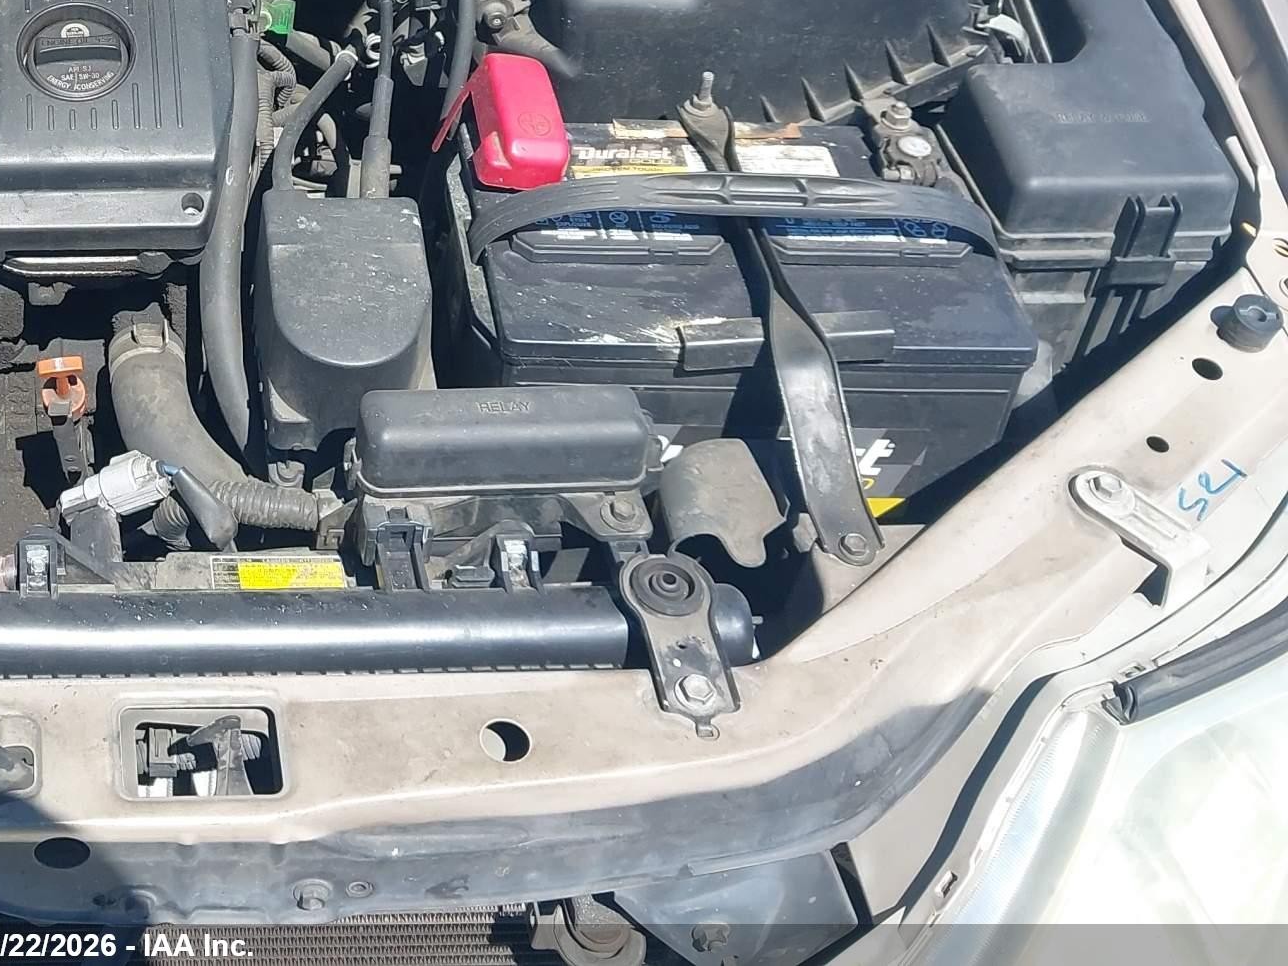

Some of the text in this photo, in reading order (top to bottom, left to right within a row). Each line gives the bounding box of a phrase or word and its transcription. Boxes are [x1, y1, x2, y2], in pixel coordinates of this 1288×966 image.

[46, 71, 115, 90] ENERGY CONSERVING
[572, 146, 673, 160] Duralast
[475, 401, 532, 414] RELAY
